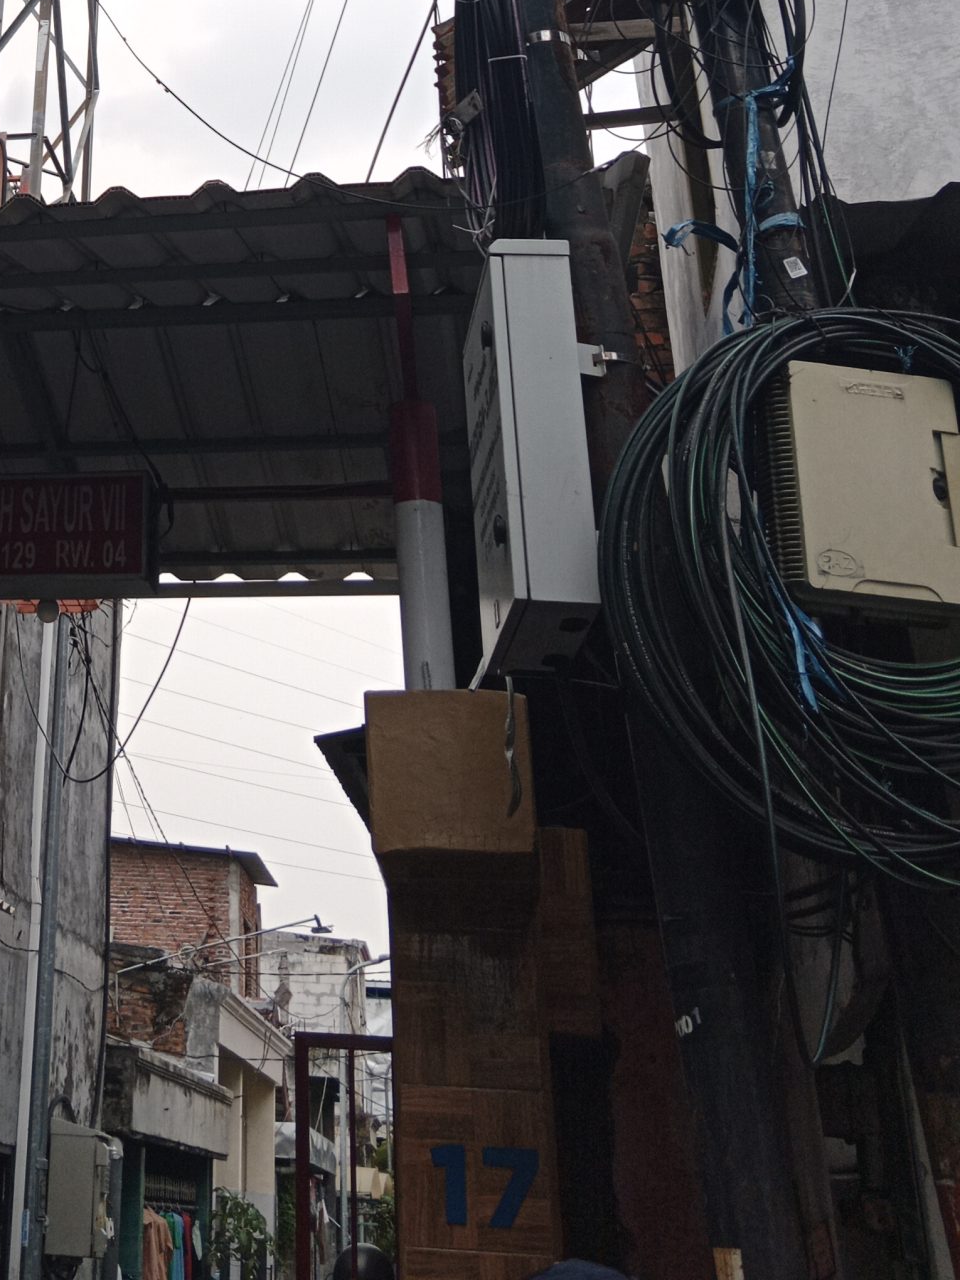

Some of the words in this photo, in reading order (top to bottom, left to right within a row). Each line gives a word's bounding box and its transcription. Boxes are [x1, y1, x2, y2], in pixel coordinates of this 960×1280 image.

[20, 485, 93, 533] SAYUR
[101, 483, 127, 532] VII
[55, 539, 95, 569] RW.
[102, 539, 127, 568] 04
[429, 1143, 540, 1229] 17
